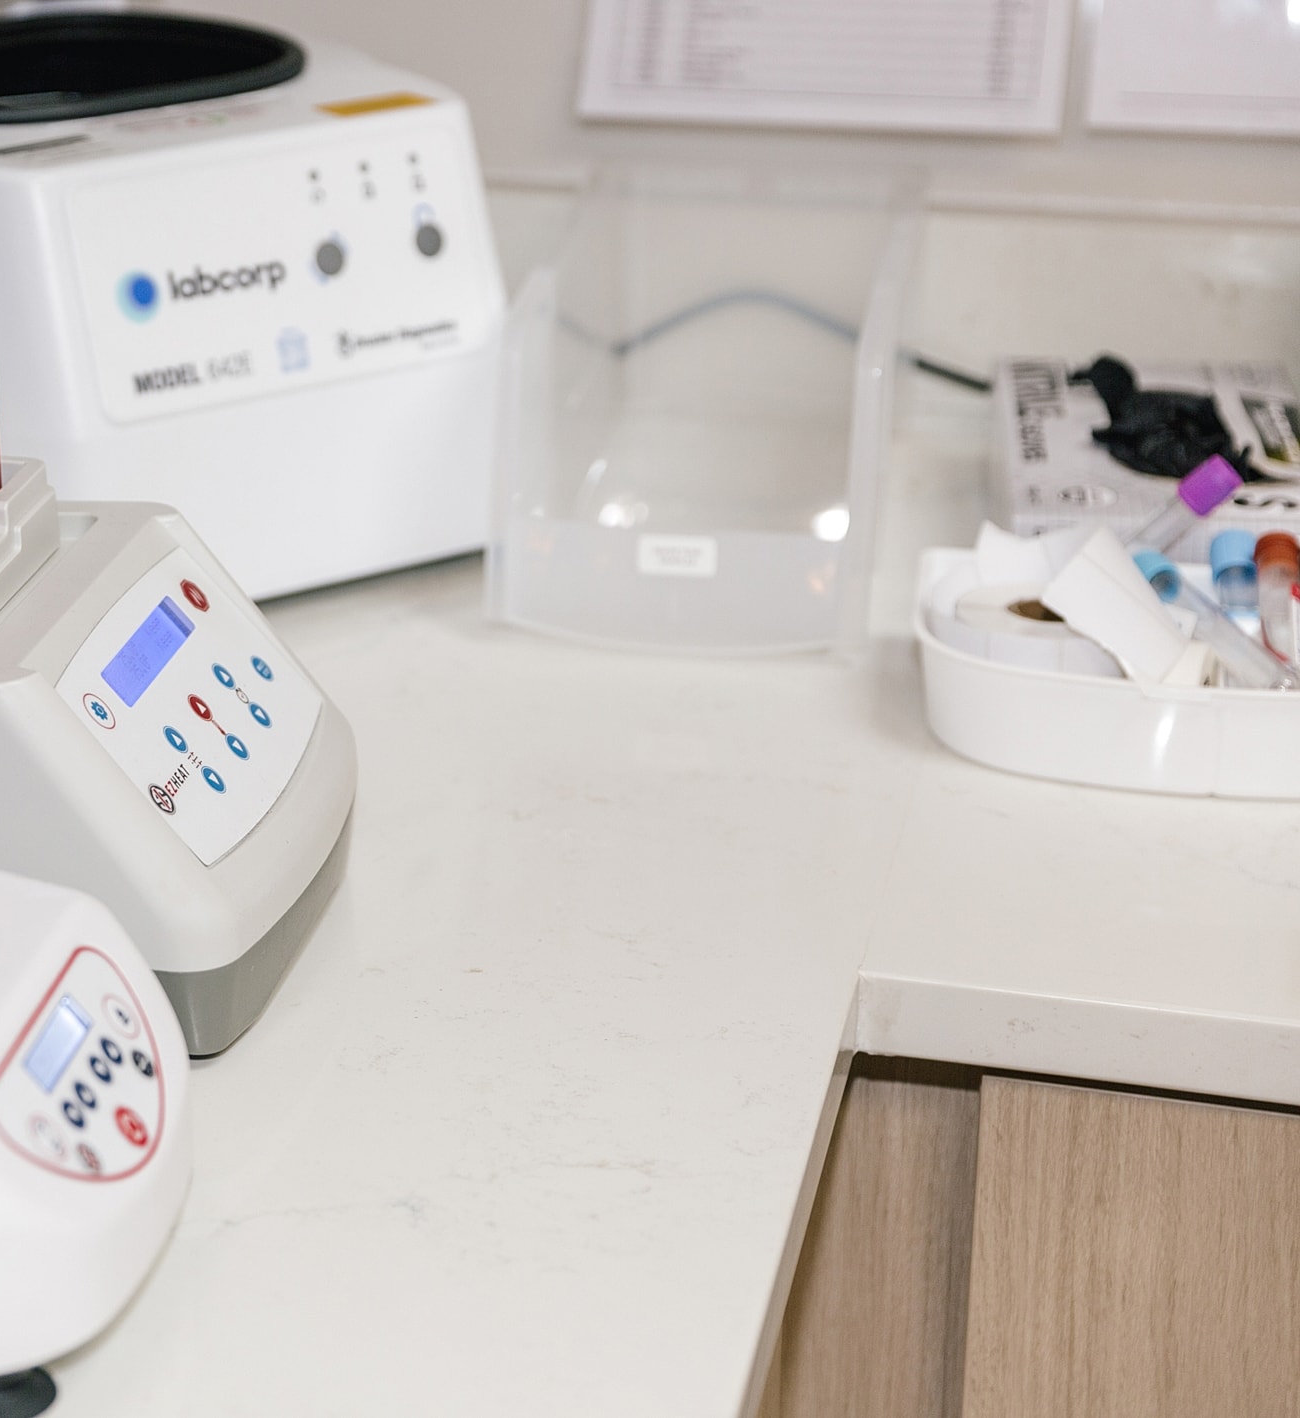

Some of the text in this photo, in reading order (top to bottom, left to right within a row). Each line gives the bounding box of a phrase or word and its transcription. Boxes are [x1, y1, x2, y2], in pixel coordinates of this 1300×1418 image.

[167, 260, 287, 301] labcorp
[133, 362, 202, 394] MODEL
[164, 763, 190, 797] EZHEAT
